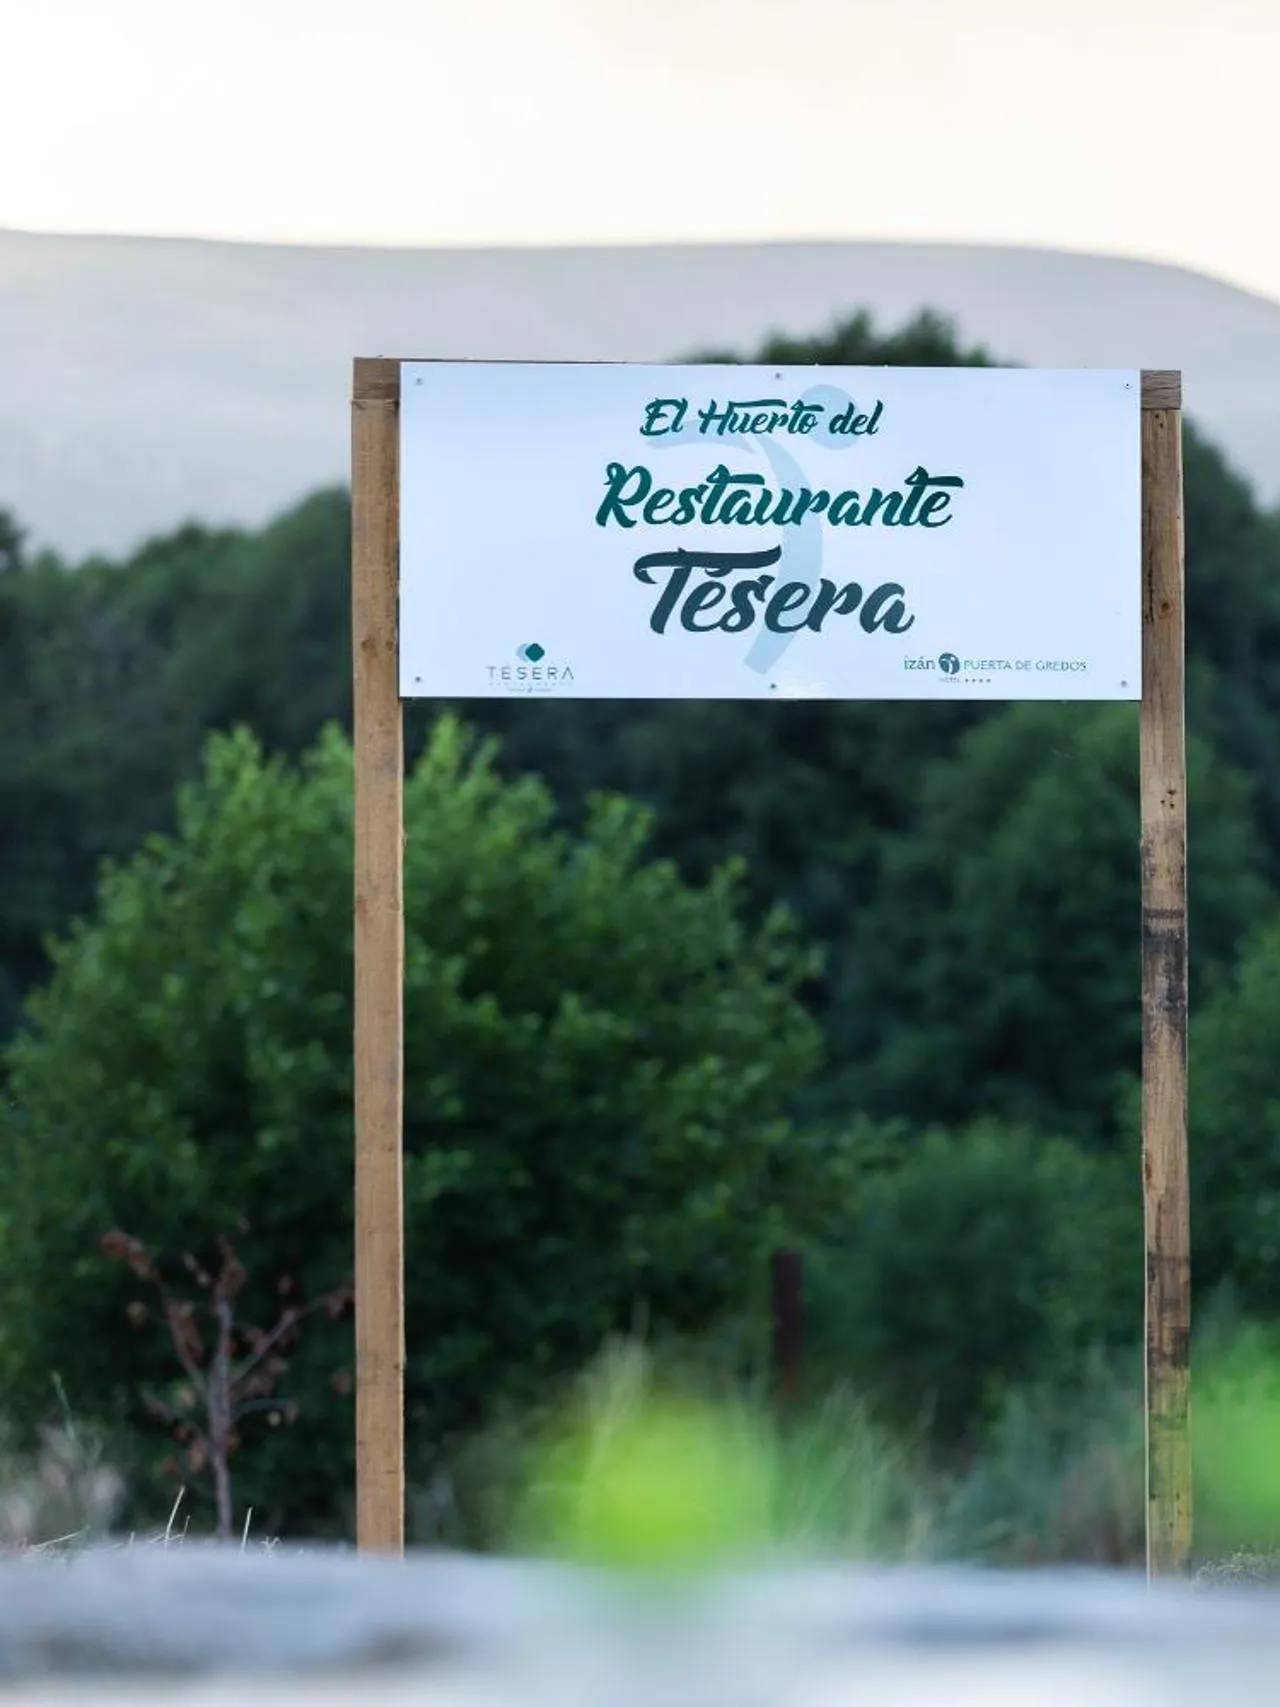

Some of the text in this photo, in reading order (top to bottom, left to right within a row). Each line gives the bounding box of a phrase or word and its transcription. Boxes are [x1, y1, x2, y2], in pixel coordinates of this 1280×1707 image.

[639, 398, 884, 437] El Huerto del
[595, 462, 965, 528] Restaurante
[633, 544, 916, 635] Tesera
[486, 665, 575, 681] TESERA
[963, 659, 1012, 671] PUERTA
[1015, 660, 1031, 671] DE
[1035, 660, 1087, 671] GREDOS
